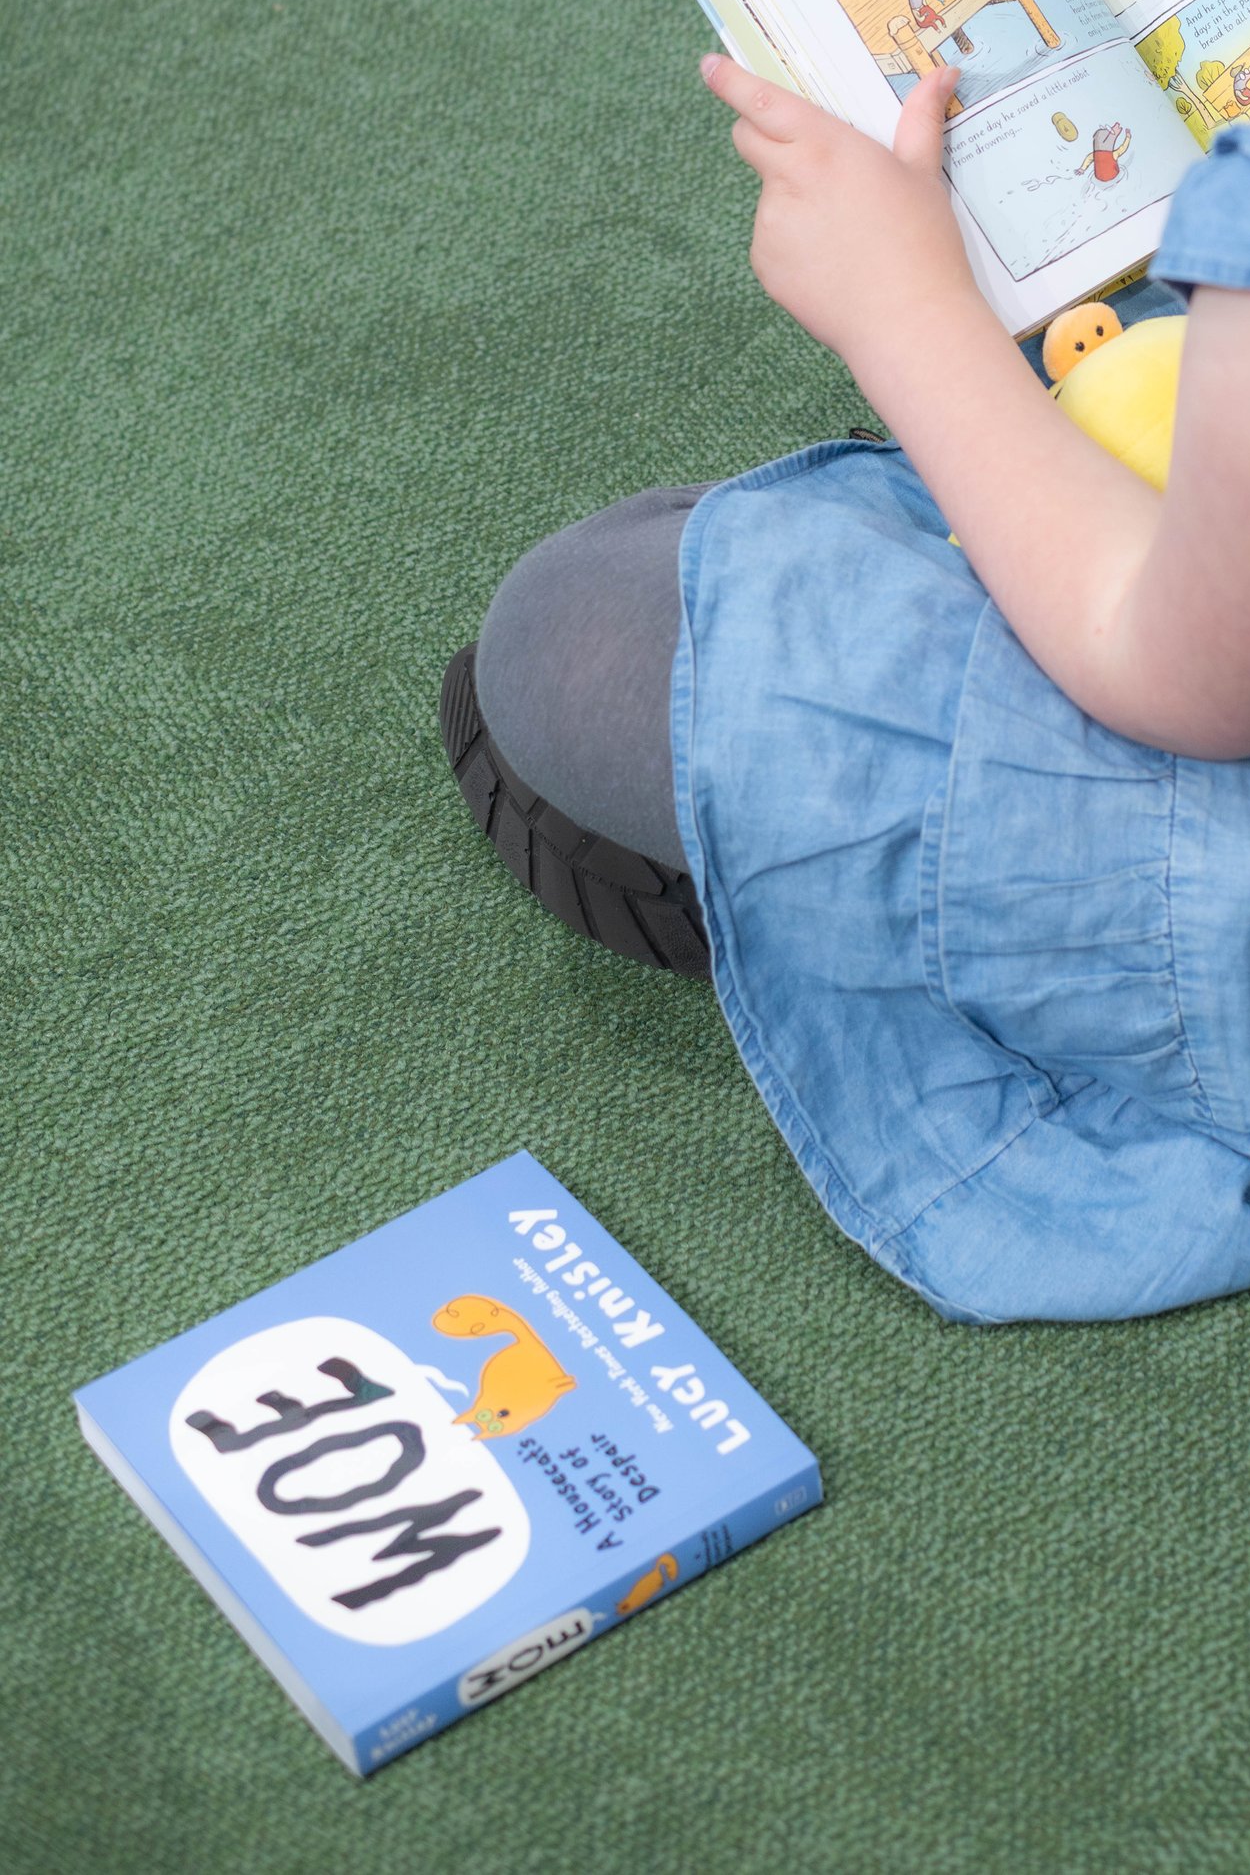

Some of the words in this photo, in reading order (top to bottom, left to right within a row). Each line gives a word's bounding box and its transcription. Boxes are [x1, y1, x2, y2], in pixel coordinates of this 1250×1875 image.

[1185, 8, 1203, 27] And
[1202, 3, 1216, 14] he
[1193, 22, 1212, 39] days
[1213, 14, 1223, 25] in
[1222, 2, 1239, 17] the
[1198, 30, 1224, 51] bread
[1223, 22, 1234, 34] to
[1235, 11, 1248, 26] all
[943, 137, 967, 157] Then
[968, 129, 985, 144] one
[986, 119, 1003, 134] day
[1001, 109, 1016, 123] he
[1016, 94, 1040, 116] saved
[1045, 82, 1068, 98] little
[1068, 68, 1091, 86] rabbit
[952, 151, 974, 169] from
[975, 125, 1023, 156] drowning...
[512, 1257, 550, 1295] Author
[545, 1290, 600, 1350] Bestselling
[594, 1345, 628, 1381] Times
[619, 1376, 651, 1408] York
[646, 1403, 675, 1434] New
[558, 1447, 589, 1469] of
[590, 1434, 661, 1505] Despair
[184, 1356, 503, 1611] WOE
[518, 1436, 603, 1535] Housecat's
[585, 1472, 634, 1523] Story
[596, 1531, 624, 1553] A
[466, 1619, 585, 1701] WOE
